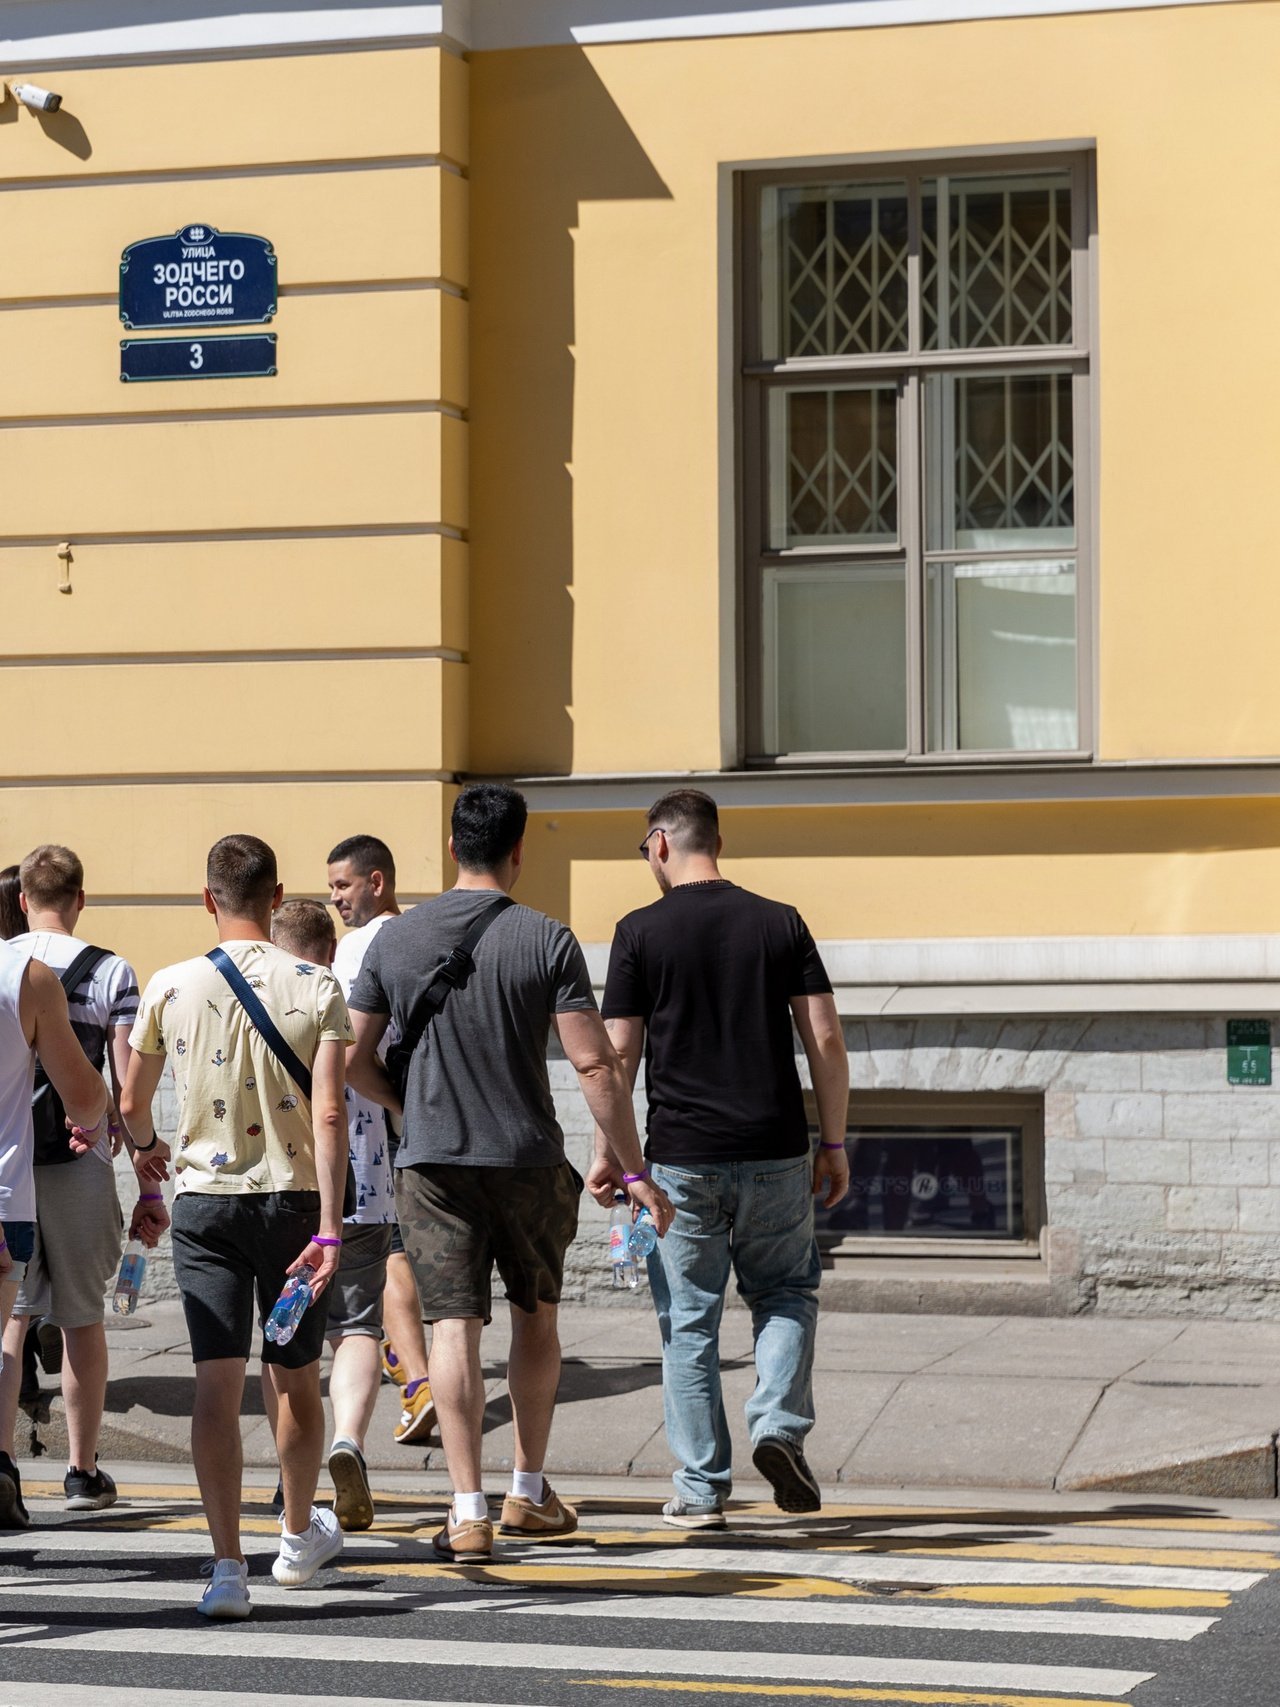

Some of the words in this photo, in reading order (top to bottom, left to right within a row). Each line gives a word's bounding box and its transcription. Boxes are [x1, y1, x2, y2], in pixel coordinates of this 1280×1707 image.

[181, 246, 216, 259] УЛИЦА
[153, 259, 245, 287] ЗОДЧЕГО
[165, 284, 233, 308] РОССИ
[216, 307, 235, 316] ROSSI
[189, 343, 204, 370] 3
[849, 1176, 910, 1195] SSI'S
[938, 1176, 1002, 1196] CLUB
